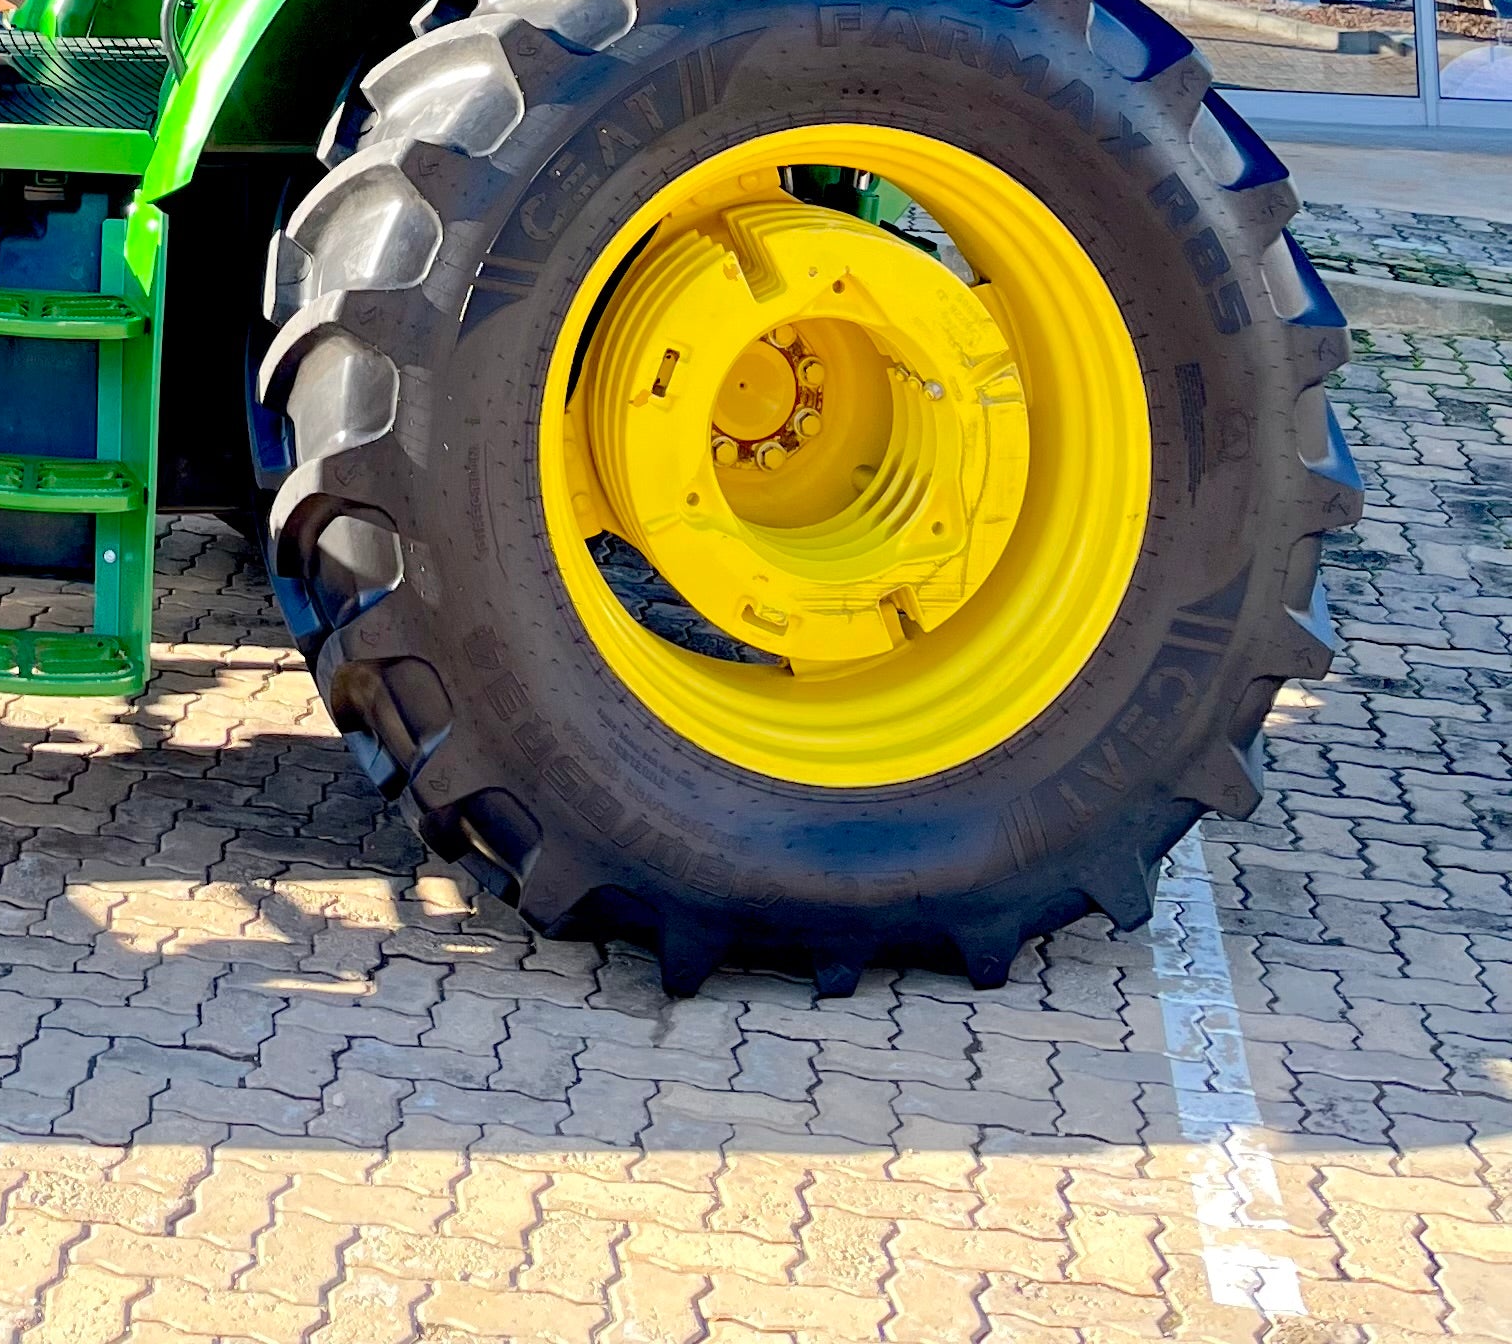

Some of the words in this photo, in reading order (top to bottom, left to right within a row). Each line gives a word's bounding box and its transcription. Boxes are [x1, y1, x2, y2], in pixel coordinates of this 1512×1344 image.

[519, 81, 664, 242] CEAT
[817, 2, 1152, 171] FARMAX
[1146, 171, 1253, 336] R85
